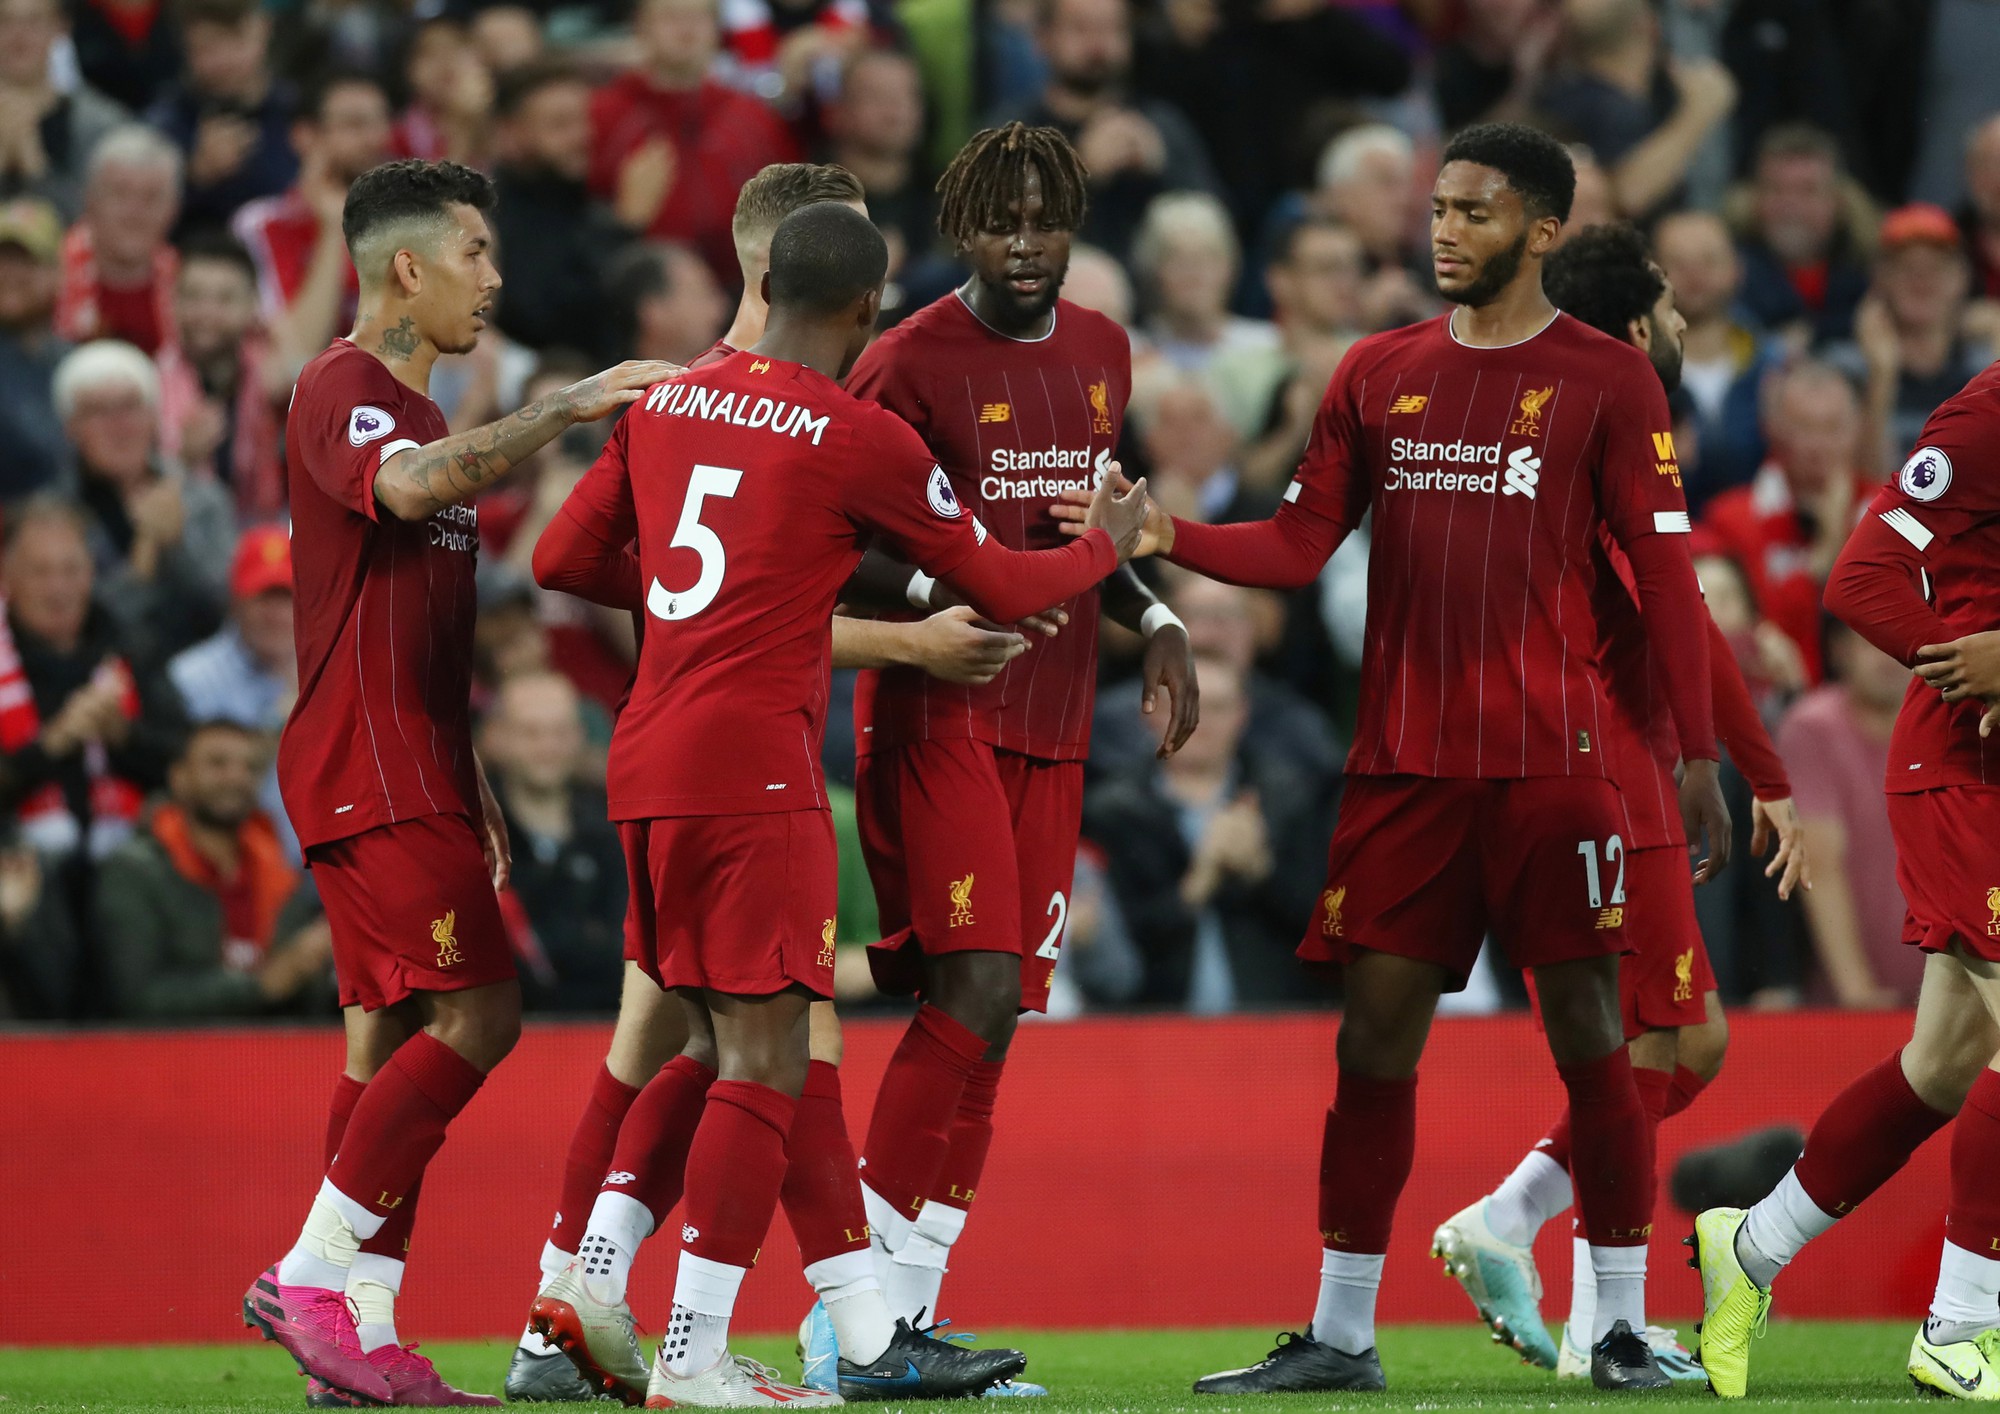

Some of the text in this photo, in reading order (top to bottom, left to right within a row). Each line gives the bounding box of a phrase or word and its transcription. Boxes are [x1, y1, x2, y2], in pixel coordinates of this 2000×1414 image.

[645, 384, 831, 446] WIJNALDUM
[991, 444, 1090, 472] Standard
[1391, 437, 1501, 464] Standard
[980, 475, 1088, 501] Chartered
[1384, 467, 1497, 494] Chartered
[646, 464, 744, 621] 5
[1577, 834, 1626, 908] 12
[1035, 891, 1067, 960] 2
